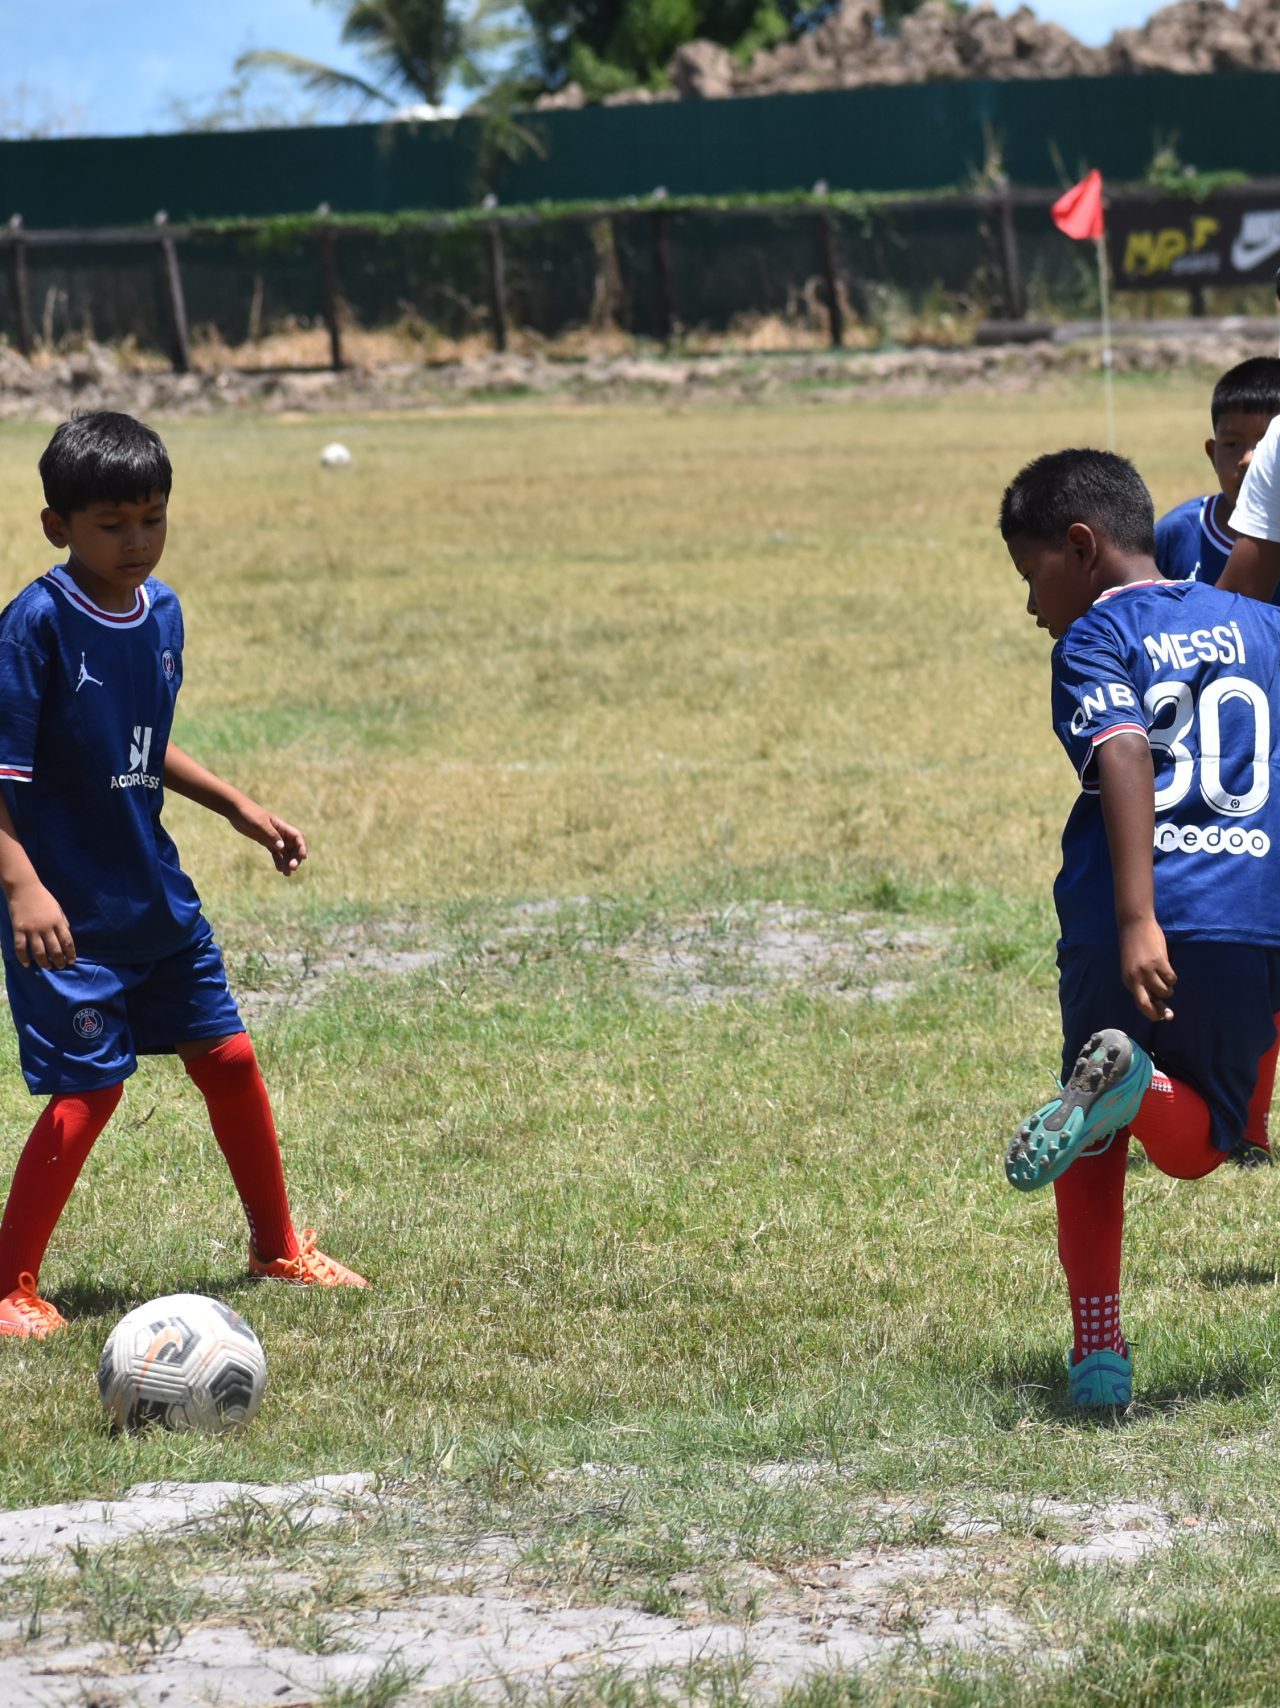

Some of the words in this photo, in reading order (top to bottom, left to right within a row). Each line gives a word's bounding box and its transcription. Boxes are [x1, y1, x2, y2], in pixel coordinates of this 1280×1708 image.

[1143, 621, 1246, 671] MESSI
[1070, 682, 1135, 735] QNB
[1143, 676, 1270, 817] 30
